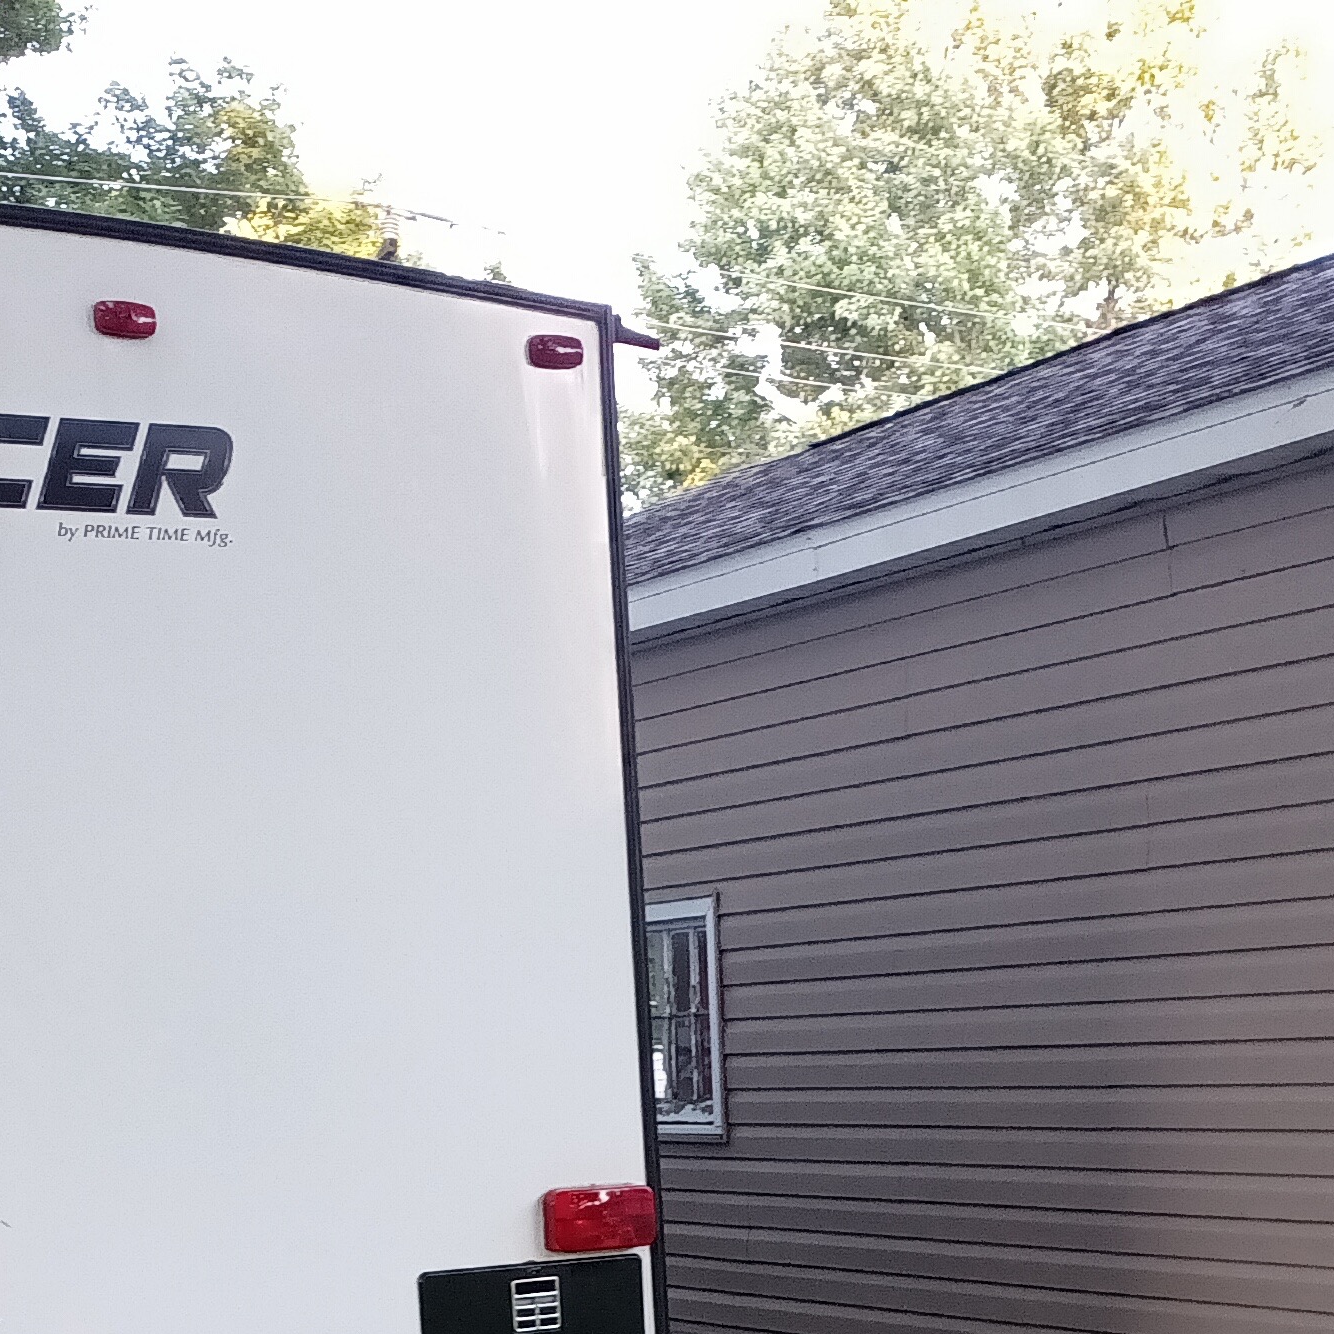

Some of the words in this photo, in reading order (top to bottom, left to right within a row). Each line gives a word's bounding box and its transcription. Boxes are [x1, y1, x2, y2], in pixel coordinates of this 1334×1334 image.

[57, 522, 79, 542] by
[83, 524, 141, 541] PRIME
[146, 526, 191, 542] TIME
[194, 528, 233, 548] Mfg.
